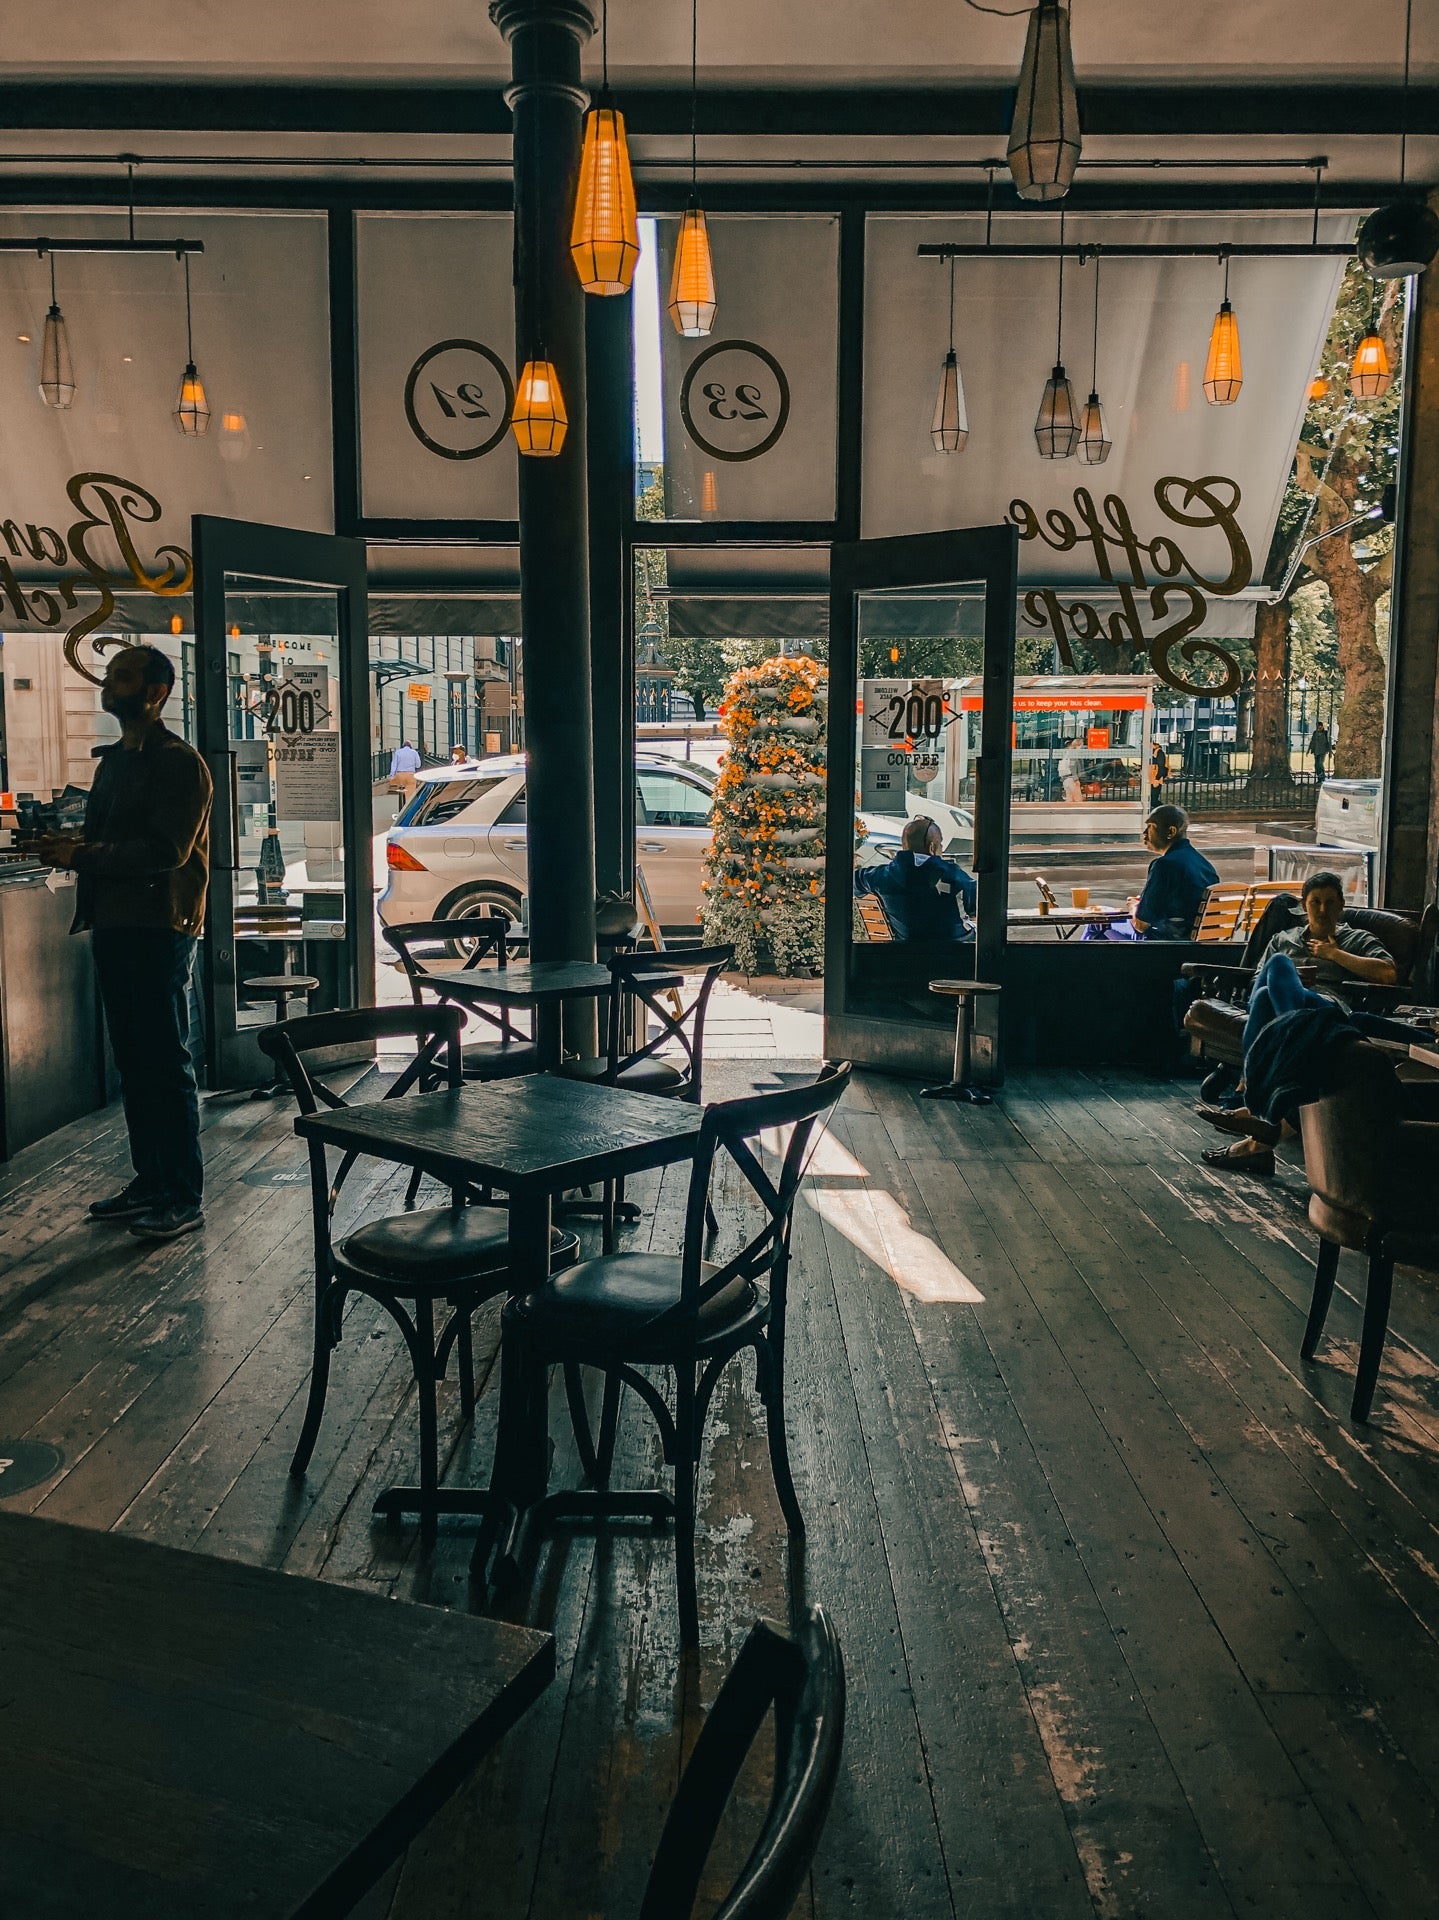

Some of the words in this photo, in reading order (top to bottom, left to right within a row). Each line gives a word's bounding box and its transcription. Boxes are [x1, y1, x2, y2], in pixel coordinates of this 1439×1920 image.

[281, 656, 294, 666] TO
[267, 748, 315, 762] COFFEE
[887, 753, 939, 766] COFFEE
